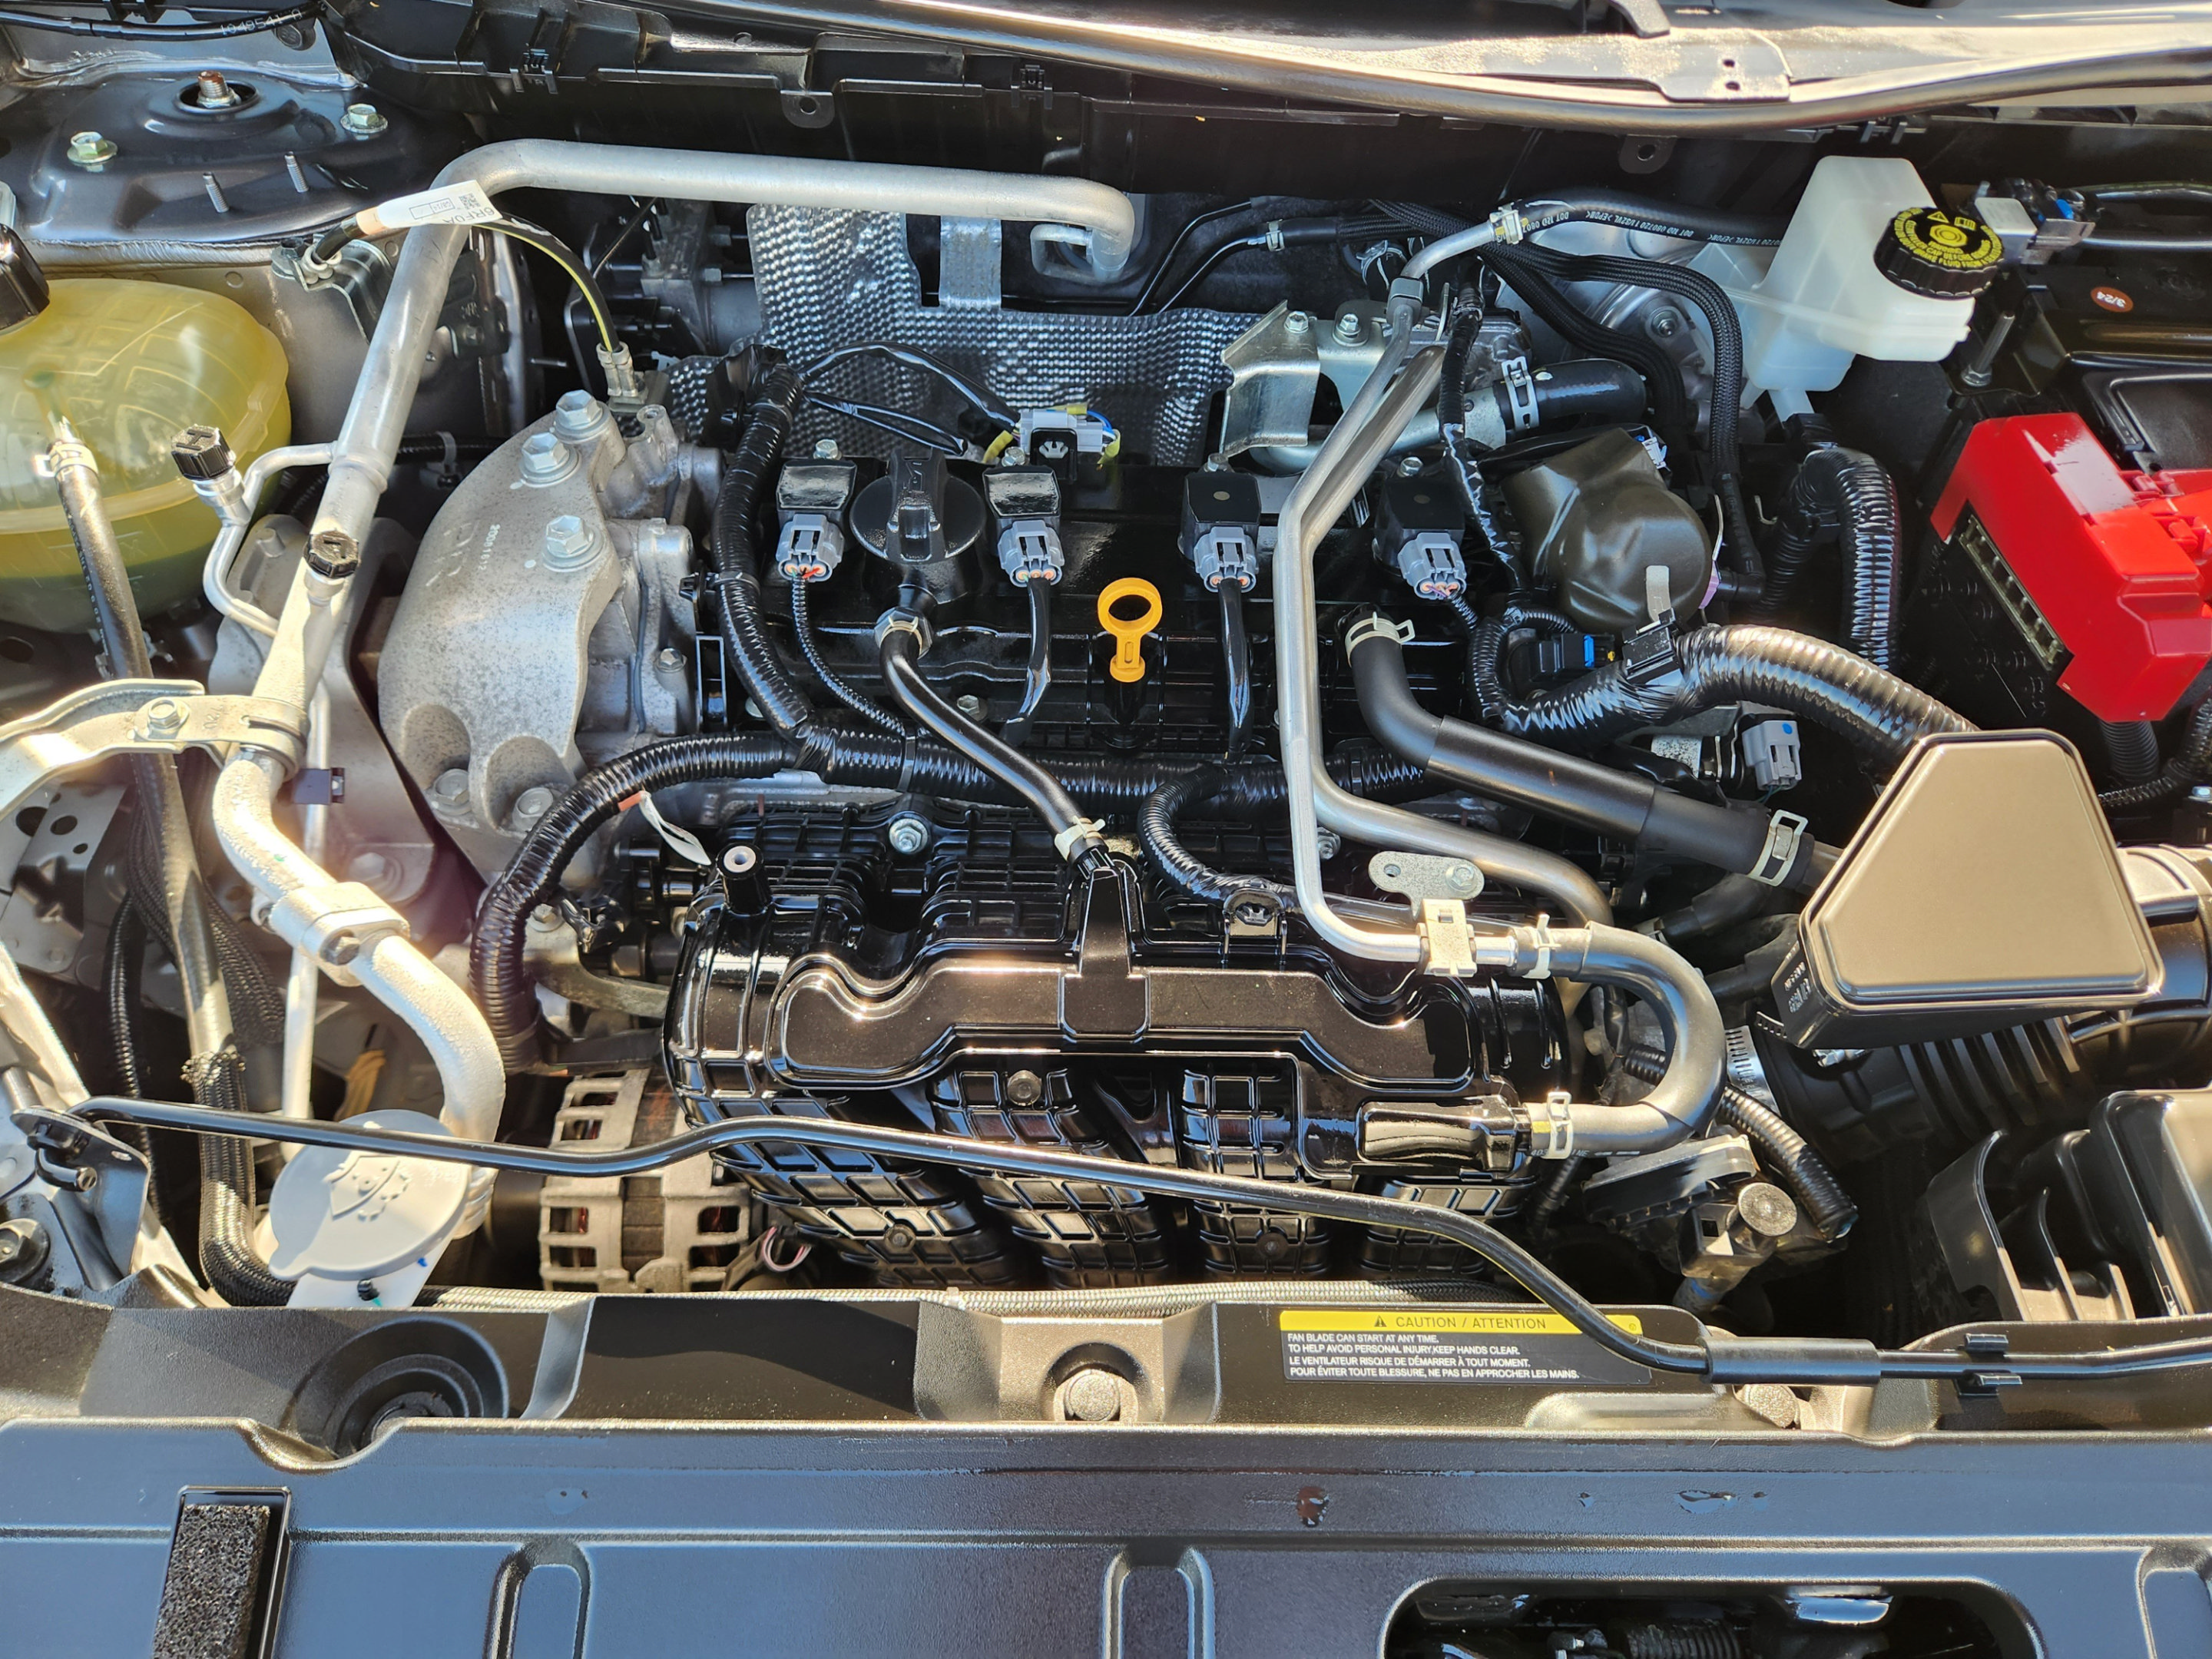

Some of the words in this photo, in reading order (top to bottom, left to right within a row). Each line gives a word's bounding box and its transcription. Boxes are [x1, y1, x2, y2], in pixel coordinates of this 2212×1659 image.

[1556, 211, 1570, 221] DOT
[2096, 291, 2126, 309] 3/24
[176, 429, 213, 451] H
[1396, 1317, 1456, 1328] CAUTION
[1462, 1317, 1468, 1328] /
[1472, 1318, 1546, 1329] ATTENTION
[1287, 1333, 1305, 1343] FAN
[1306, 1333, 1335, 1343] BLADE
[1336, 1333, 1356, 1343] CAN
[1356, 1334, 1383, 1343] START
[1385, 1334, 1396, 1343] AT
[1397, 1334, 1415, 1343] ANY
[1416, 1334, 1439, 1344] TIME.
[1288, 1344, 1301, 1353] TO
[1303, 1344, 1325, 1353] HELP
[1326, 1344, 1353, 1353] AVOID
[1355, 1345, 1402, 1354] PERSONAL
[1457, 1346, 1488, 1355] HANDS
[1489, 1346, 1521, 1356] CLEAR.
[1289, 1356, 1301, 1366] LE
[1302, 1356, 1359, 1366] VENTILATEUR
[1359, 1357, 1392, 1366] RISQUE
[1394, 1357, 1407, 1366] DE
[1408, 1355, 1456, 1367] DÉMARRER
[1458, 1355, 1465, 1367] À
[1465, 1358, 1489, 1367] TOUT
[1490, 1358, 1531, 1368] MOMENT.
[1290, 1367, 1316, 1376] POUR
[1317, 1365, 1348, 1376] ÉVITER
[1348, 1368, 1378, 1377] TOUTE
[1379, 1368, 1427, 1379] BLESSURE,
[1429, 1369, 1442, 1377] NE
[1442, 1369, 1460, 1378] PAS
[1461, 1369, 1474, 1378] EN
[1475, 1369, 1531, 1379] APPROCHER
[1532, 1369, 1548, 1379] LES
[1549, 1370, 1580, 1379] MAINS.
